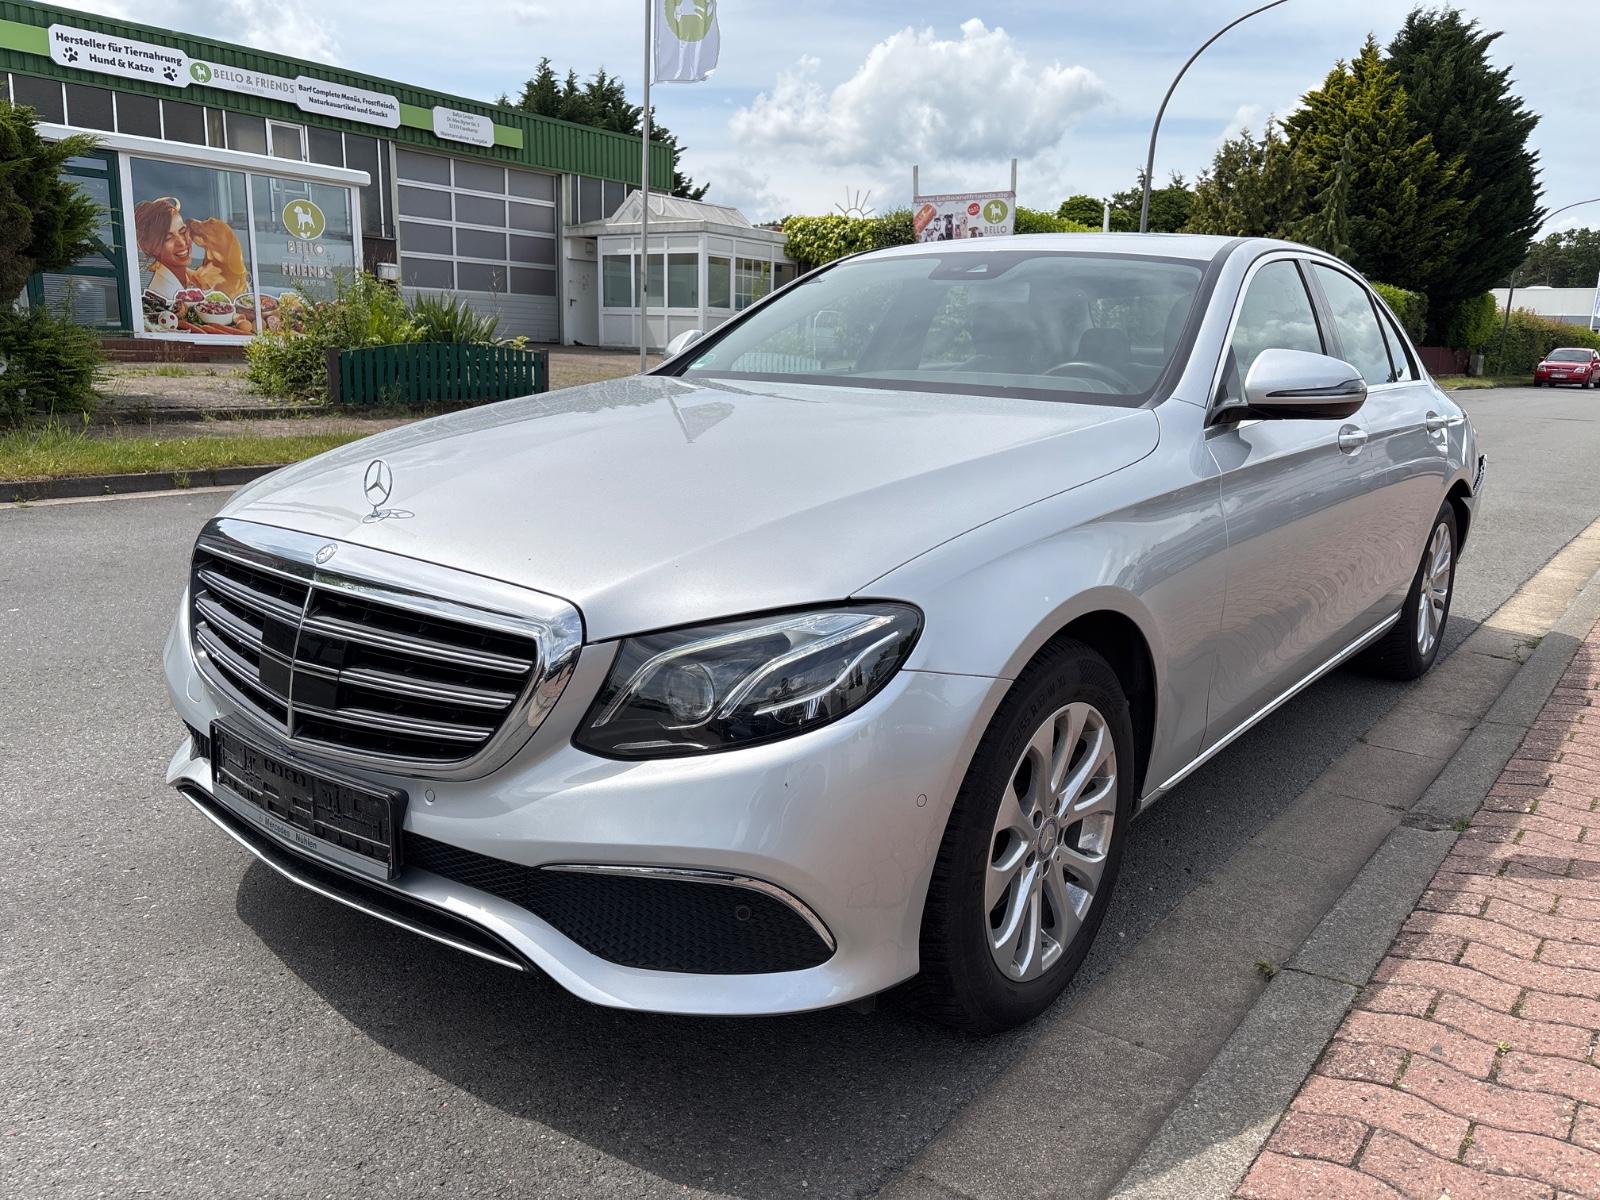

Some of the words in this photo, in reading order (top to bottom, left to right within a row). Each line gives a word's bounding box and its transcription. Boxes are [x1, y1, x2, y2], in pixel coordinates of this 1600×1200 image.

[55, 32, 106, 50] Hersteller
[107, 42, 122, 53] für
[124, 45, 183, 67] Tiernahrung
[89, 53, 116, 67] Hund
[118, 59, 126, 68] &
[128, 60, 154, 74] Katze
[213, 68, 244, 84] BELLO
[246, 76, 253, 86] &
[255, 77, 295, 94] FRIENDS
[298, 84, 312, 93] Barf
[312, 87, 340, 99] Complete
[341, 93, 362, 104] Menüs,
[362, 98, 396, 111] Frostfleisch,
[309, 96, 356, 112] Naturkauartikel
[357, 106, 368, 114] und
[368, 109, 388, 118] Snacks
[984, 225, 1007, 234] BELLO
[287, 240, 326, 256] BELLO
[281, 262, 333, 280] FRIENDS
